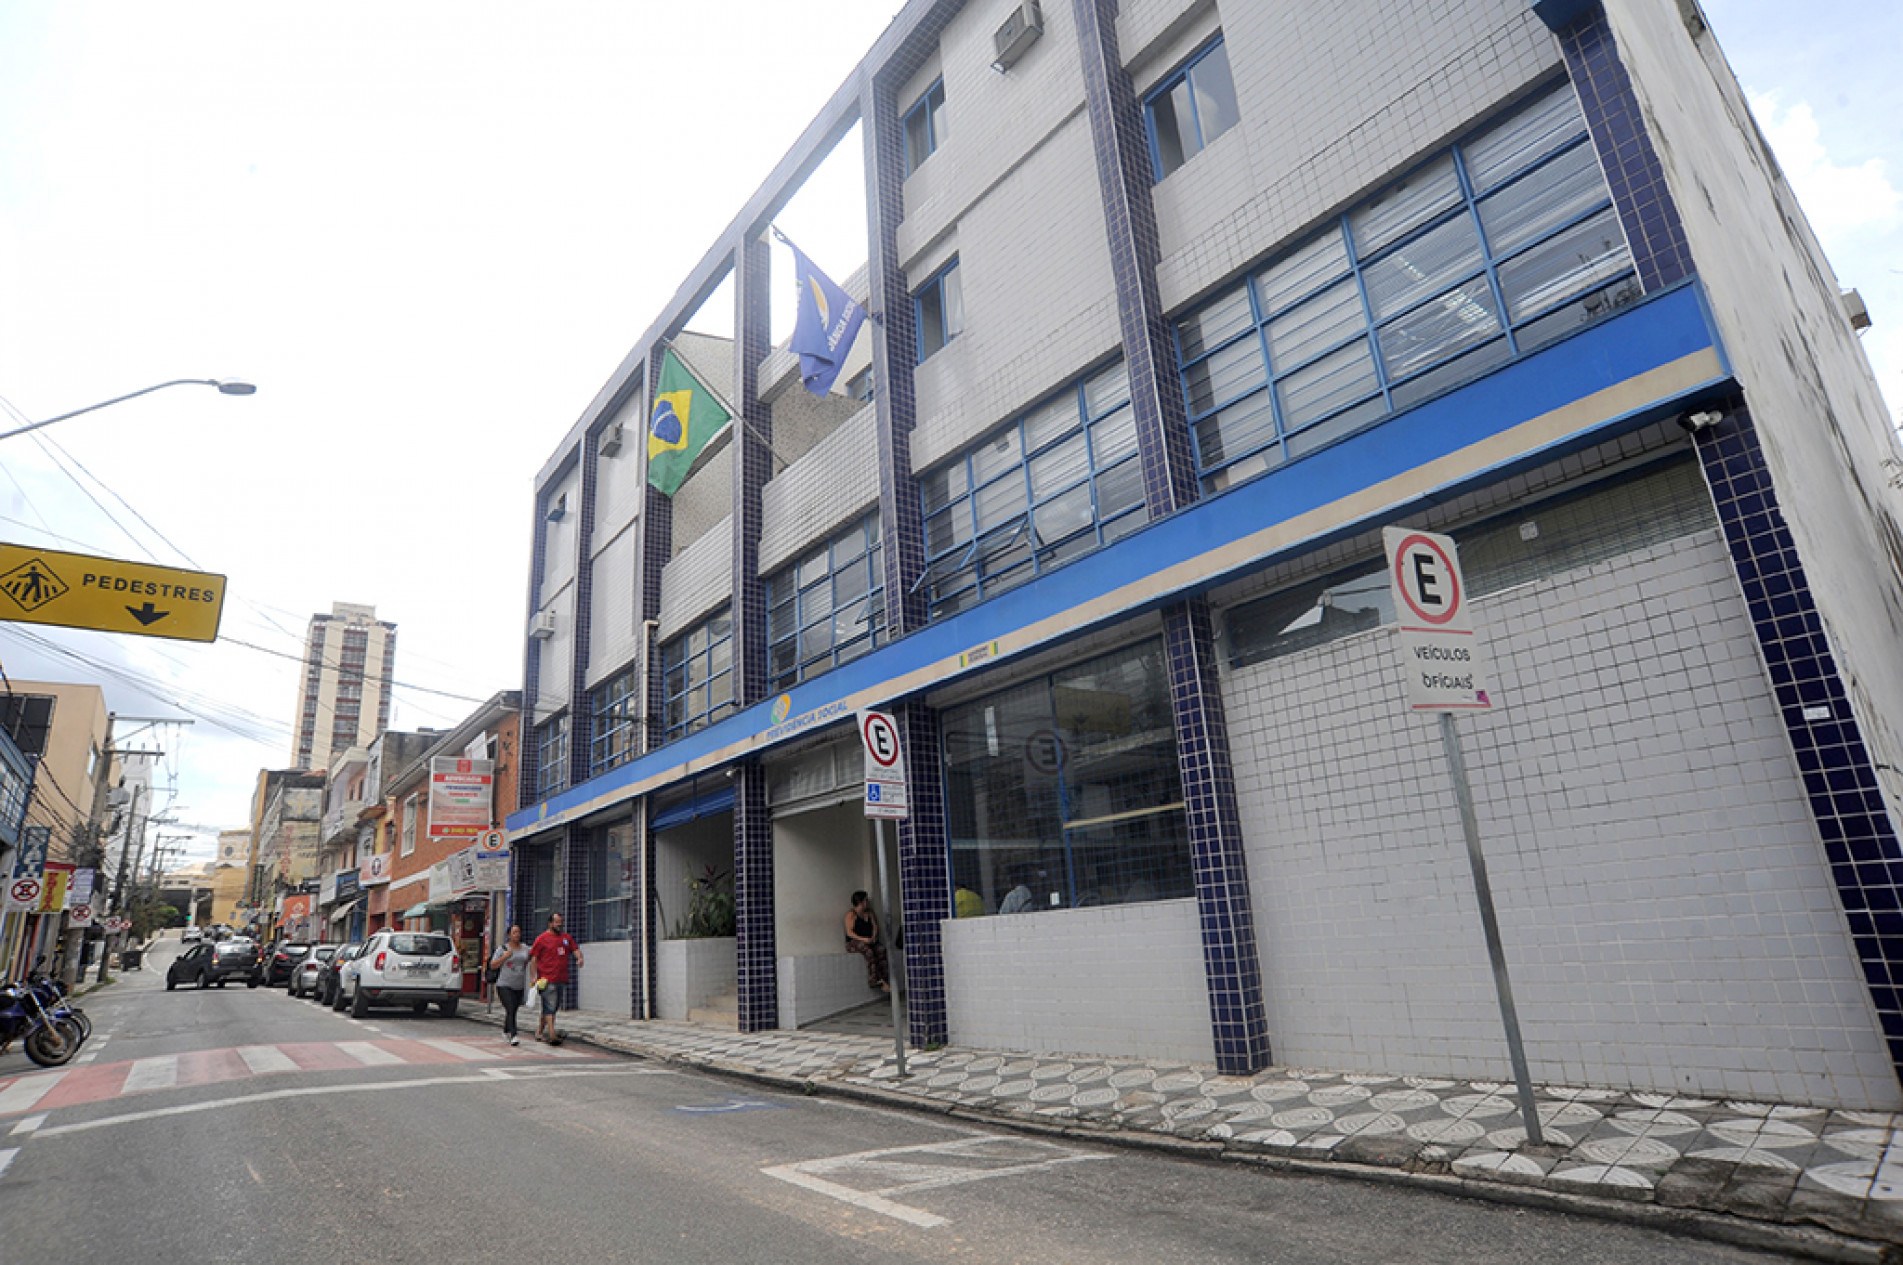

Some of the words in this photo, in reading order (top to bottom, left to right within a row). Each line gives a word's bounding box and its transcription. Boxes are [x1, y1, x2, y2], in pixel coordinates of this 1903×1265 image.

[82, 573, 215, 603] PEDESTRES
[1413, 553, 1442, 604] E
[1413, 644, 1471, 662] VEÍCULOS
[817, 700, 848, 720] SOCIAL
[874, 724, 890, 756] E
[489, 833, 498, 847] E
